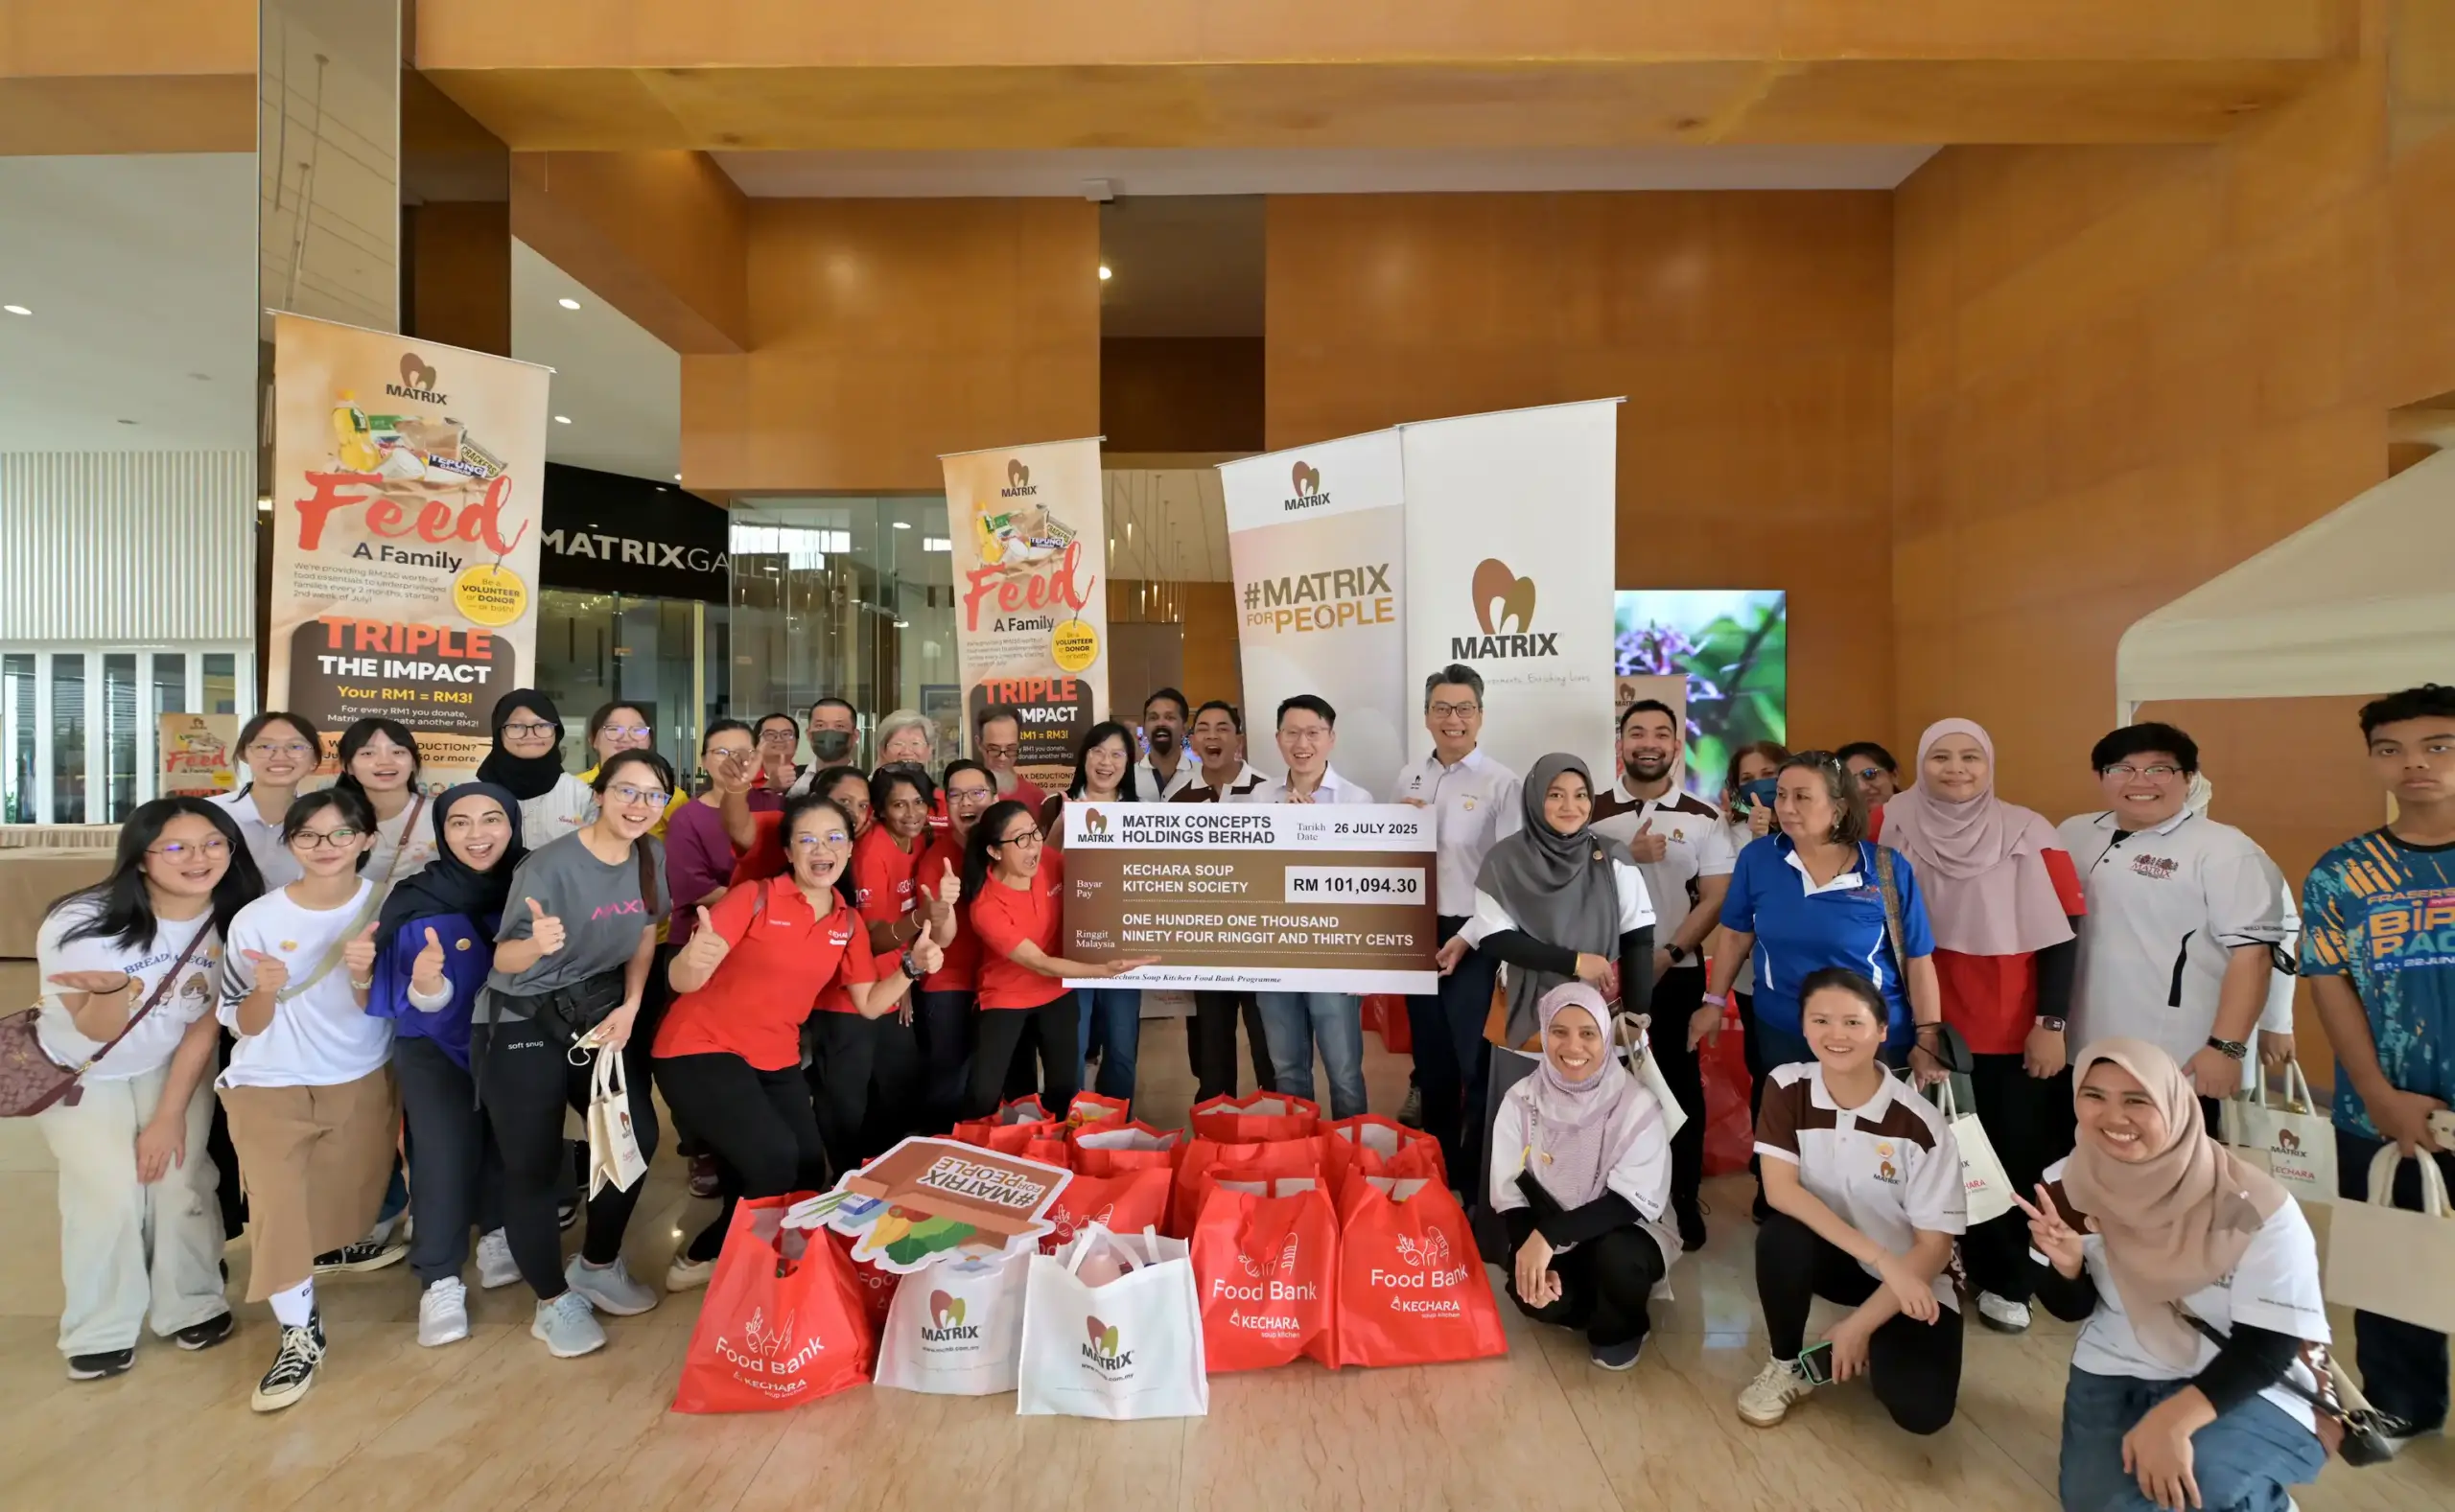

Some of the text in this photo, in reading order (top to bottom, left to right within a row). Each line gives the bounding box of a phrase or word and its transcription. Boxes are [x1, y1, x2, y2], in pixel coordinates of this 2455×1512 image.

[386, 384, 448, 405] MATRIX
[430, 454, 486, 476] TEPUNG
[461, 446, 498, 476] CRACKERS
[1001, 486, 1037, 498] MATRIX
[1284, 492, 1331, 511] MATRIX
[294, 471, 528, 556] Feed
[353, 542, 462, 572] A Family
[293, 562, 320, 571] We're
[322, 567, 366, 577] providing
[401, 574, 429, 583] worth
[317, 573, 364, 585] essentials
[377, 580, 447, 593] underprivileged
[482, 578, 494, 587] Be
[963, 541, 1095, 633] Feed
[1244, 563, 1392, 610] #MATRIX
[293, 581, 328, 590] families
[330, 585, 356, 593] every
[404, 592, 439, 602] starting
[293, 590, 310, 598] 2nd
[312, 592, 337, 600] week
[462, 585, 521, 597] VOLUNTEER
[478, 594, 516, 605] DONOR
[490, 603, 515, 614] both!
[1247, 596, 1395, 634] FOR PEOPLE
[994, 616, 1055, 633] A Family
[318, 615, 492, 660] TRIPLE
[1055, 638, 1093, 646] VOLUNTEER
[1452, 633, 1559, 660] MATRIX
[317, 655, 492, 685] THE IMPACT
[338, 685, 378, 700] Your
[382, 687, 415, 702] RM1
[433, 691, 474, 705] RM3!
[981, 674, 1077, 705] TRIPLE
[341, 705, 468, 719] For every RM1 you donate,
[1020, 707, 1078, 723] MPACT
[327, 713, 479, 728] Matrix another RM2!
[1046, 730, 1068, 740] RM3!
[417, 742, 477, 753] DUCTION?
[166, 745, 229, 773] Feed
[447, 755, 479, 763] more.
[1030, 772, 1074, 780] DEDUCTION?
[1122, 815, 1272, 829] MATRIX CONCEPTS
[1297, 822, 1326, 832] Tarikh
[1334, 823, 1418, 835] 26 JULY 2025
[1077, 833, 1114, 844] MATRIX
[1122, 829, 1275, 845] HOLDINGS BERHAD
[1297, 831, 1319, 842] Date
[1123, 864, 1234, 877] KECHARA SOUP
[2132, 863, 2172, 878] MATRIX
[1076, 879, 1103, 890] Bayar
[1123, 880, 1249, 895] KITCHEN SOCIETY
[1294, 877, 1417, 895] RM 101,094.30
[1076, 889, 1093, 899] Pay
[1122, 914, 1339, 928] ONE HUNDRED ONE THOUSAND
[1076, 930, 1109, 942] Ringgit
[1122, 930, 1414, 946] NINETY FOUR RINGGIT AND THIRTY CENTS
[1076, 939, 1115, 950] Malaysia
[2373, 931, 2455, 960] RAC
[124, 953, 170, 974] BREAD
[2404, 956, 2455, 967] 22JUN
[1141, 973, 1161, 983] Soup
[1163, 973, 1192, 982] Kitchen
[1237, 975, 1282, 985] Programme
[507, 1040, 544, 1050] soft snug
[2271, 1146, 2307, 1158] MATRIX
[936, 1158, 1043, 1194] FOR PEOPLE
[1873, 1174, 1900, 1185] MATRIX
[2276, 1165, 2315, 1179] ECHARA
[922, 1170, 1036, 1206] #MATRIX
[1965, 1178, 1986, 1190] HARA
[859, 1271, 896, 1289] Foo
[1371, 1263, 1468, 1288] Food Bank
[1213, 1279, 1317, 1300] Food Bank
[1402, 1300, 1461, 1313] KECHARA
[1242, 1315, 1299, 1330] KECHARA
[922, 1325, 979, 1341] MATRIX
[1277, 1330, 1300, 1338] kitchen
[715, 1336, 825, 1375] Food Bank
[1082, 1342, 1133, 1370] MATRIX
[744, 1379, 807, 1392] KECHARA
